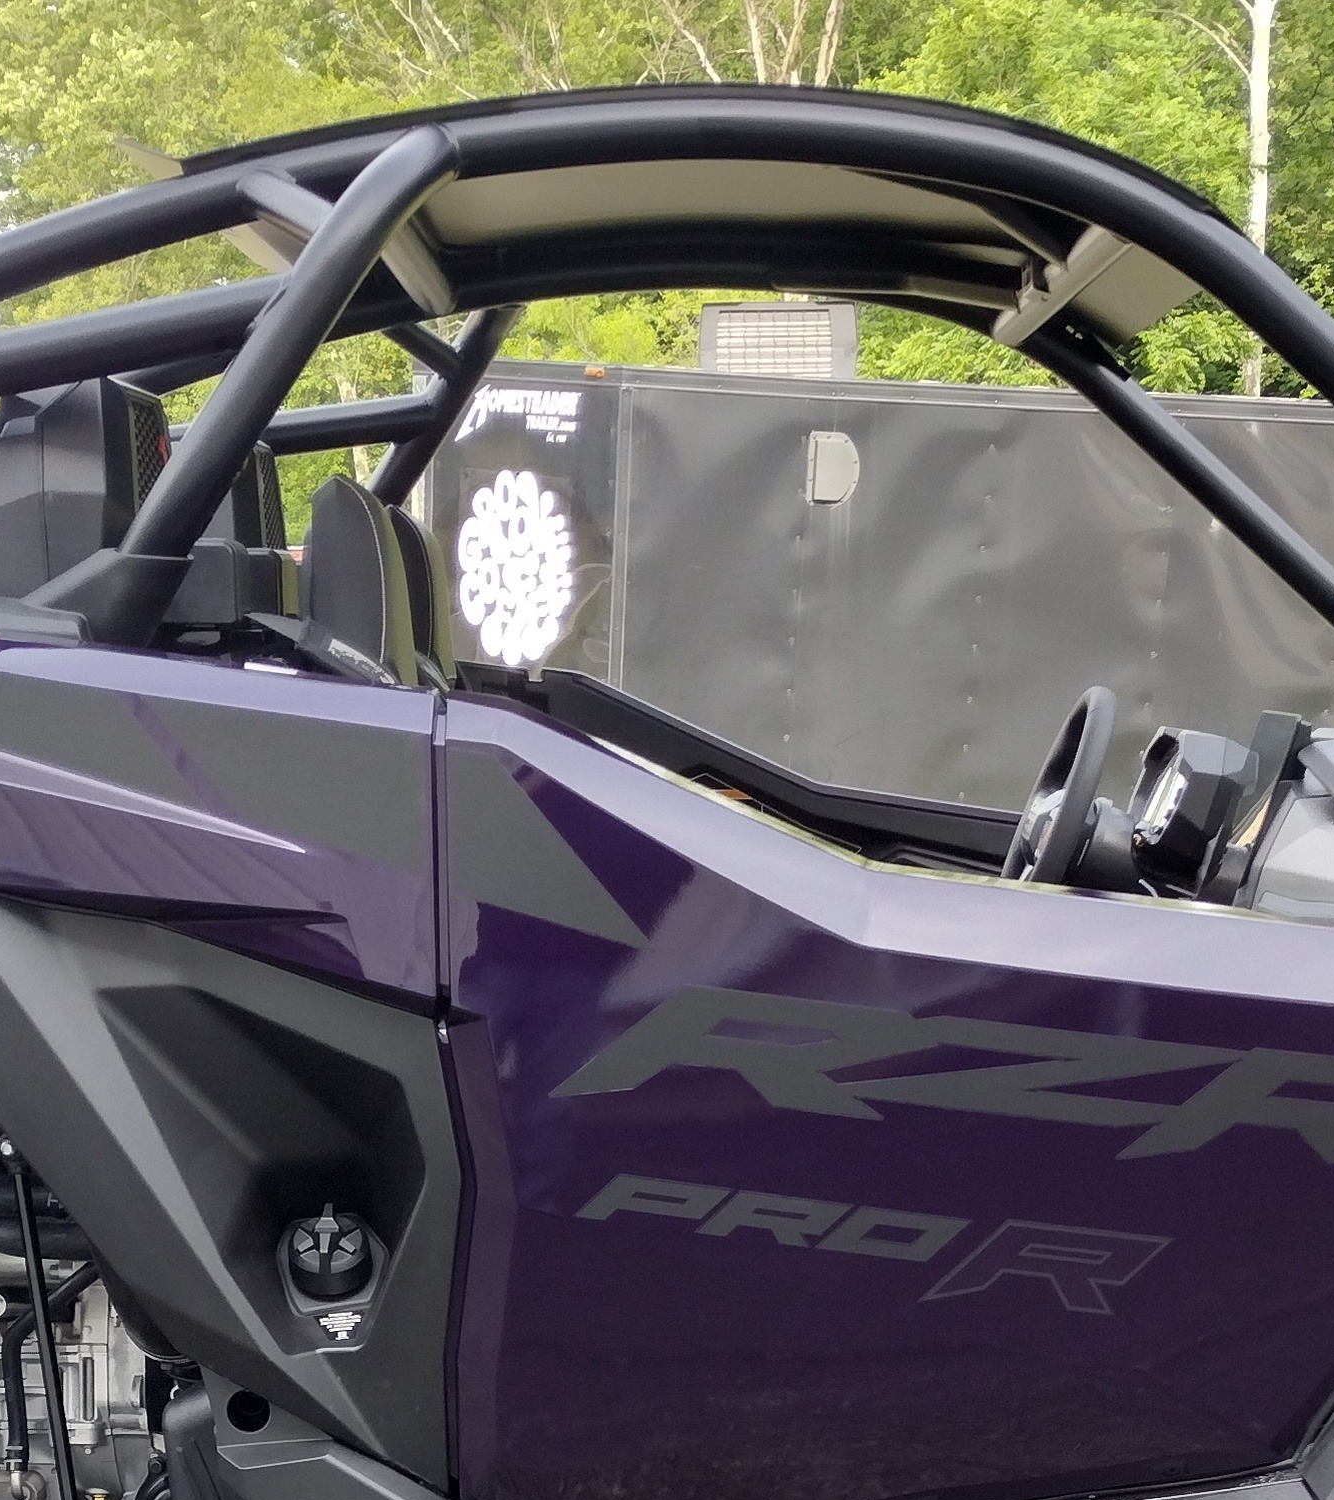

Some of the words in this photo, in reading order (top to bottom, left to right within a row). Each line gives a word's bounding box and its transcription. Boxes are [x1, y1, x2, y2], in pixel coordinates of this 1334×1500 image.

[455, 384, 579, 441] HOMESTEADER
[574, 1174, 968, 1262] PRO
[918, 1219, 1173, 1315] R
